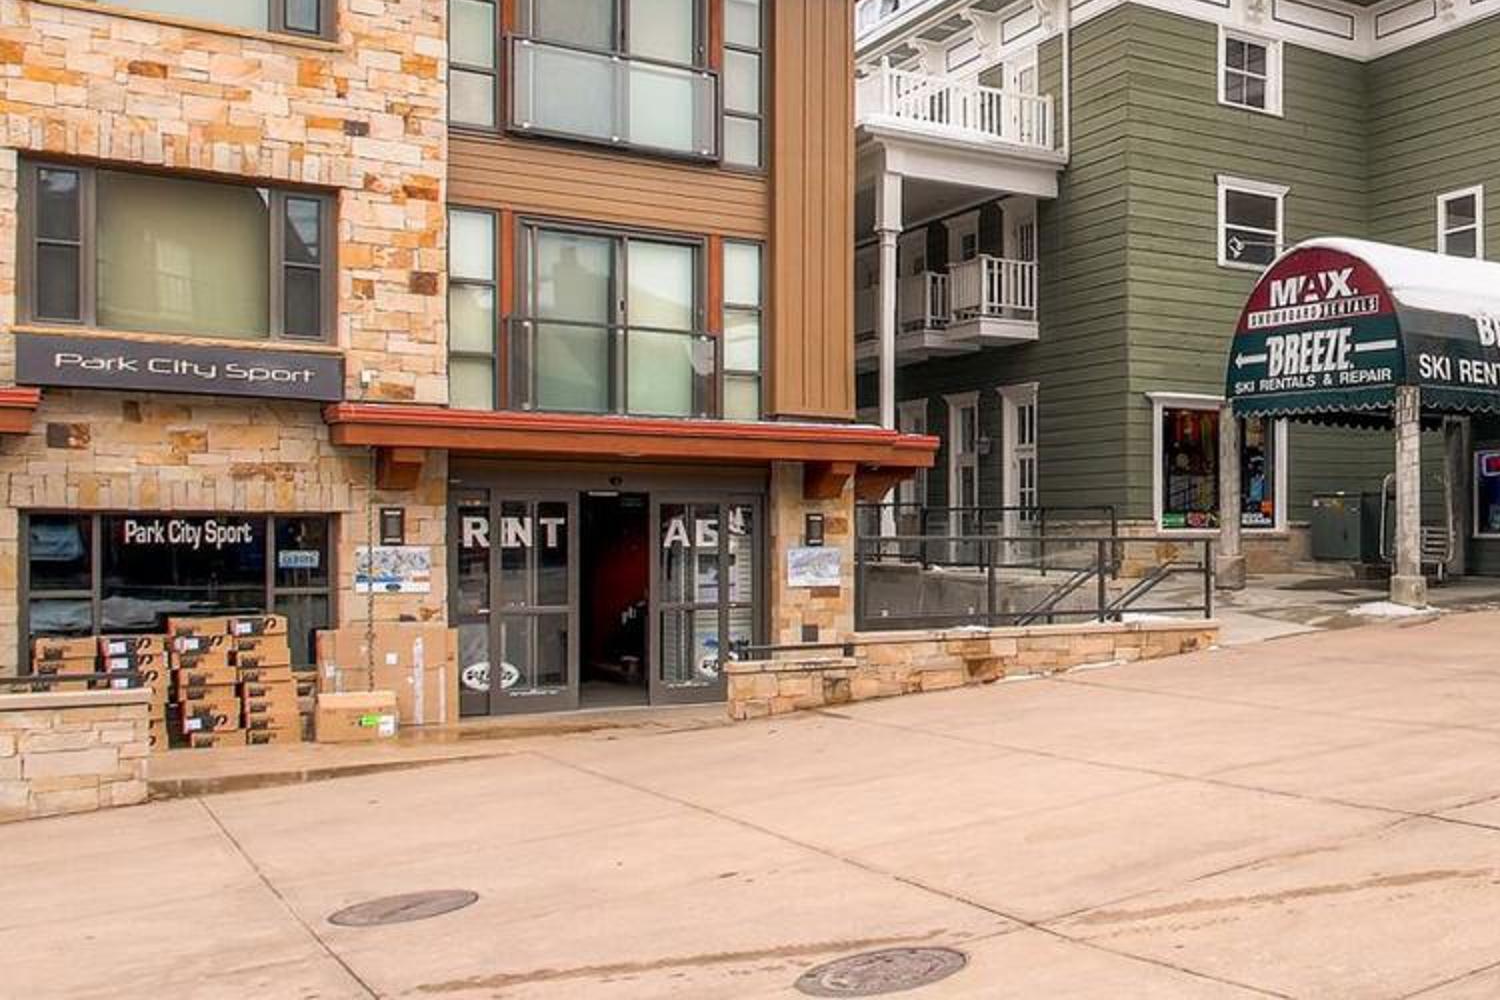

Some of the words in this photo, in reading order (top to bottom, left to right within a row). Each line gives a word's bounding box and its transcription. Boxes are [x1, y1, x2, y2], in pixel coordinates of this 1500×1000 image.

[55, 353, 139, 374] Park
[148, 358, 218, 379] City
[226, 363, 316, 384] Sport
[1235, 380, 1255, 395] SKI
[1260, 373, 1317, 391] RENTALS
[1323, 373, 1332, 386] &
[1340, 368, 1392, 385] REPAIR
[1419, 353, 1451, 381] SKI
[124, 519, 165, 543] Park
[168, 519, 202, 548] City
[205, 520, 253, 549] Sport
